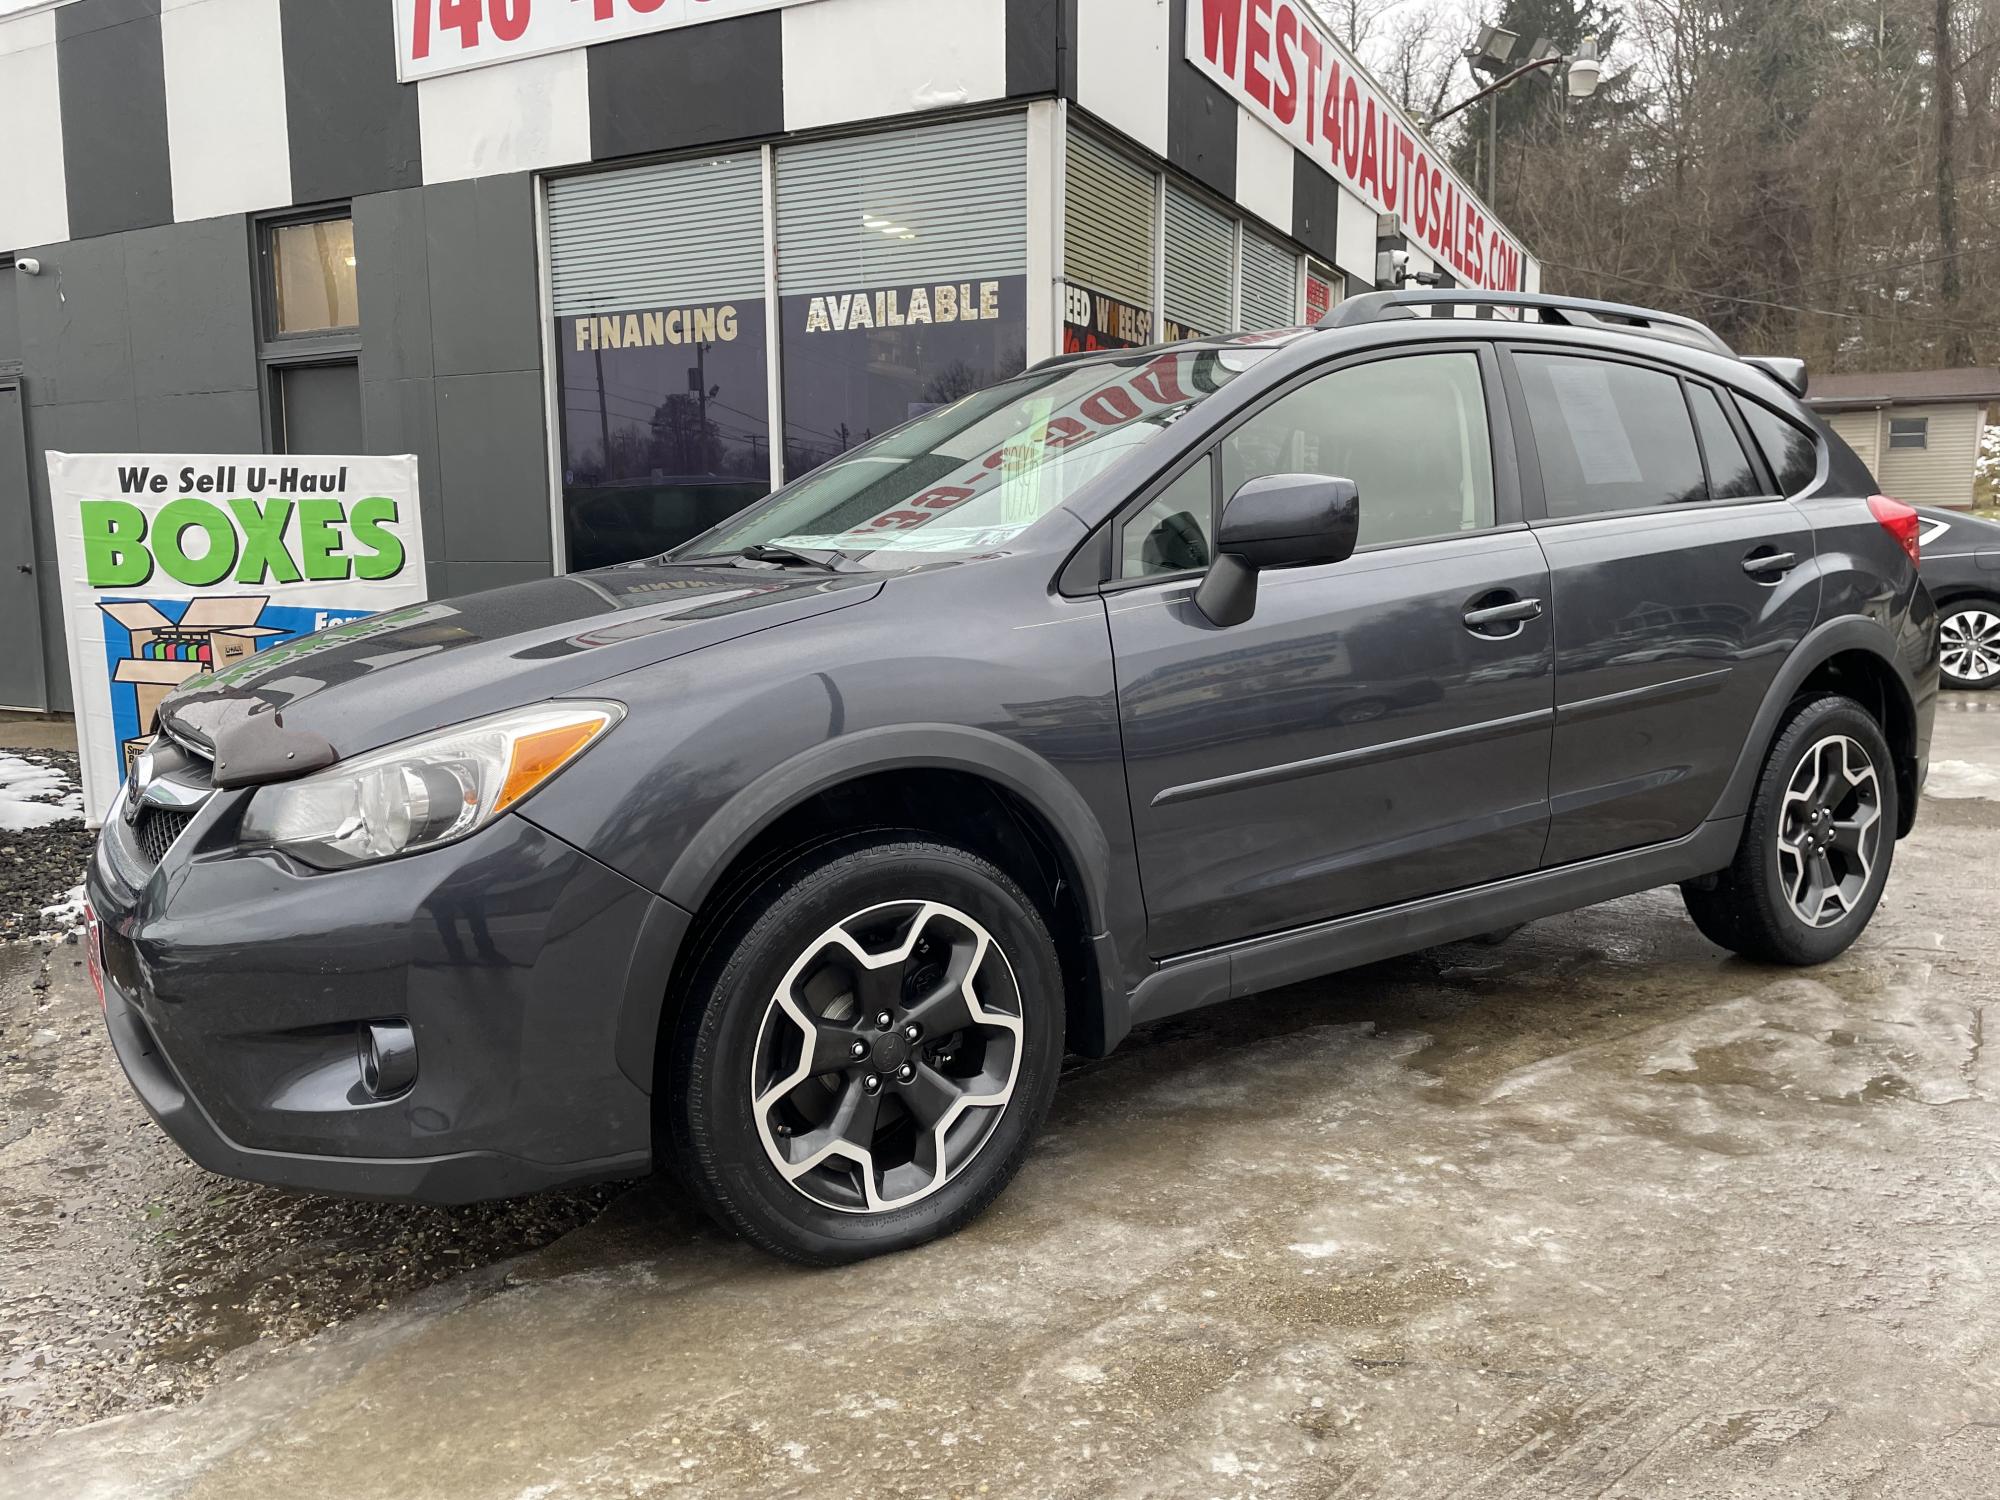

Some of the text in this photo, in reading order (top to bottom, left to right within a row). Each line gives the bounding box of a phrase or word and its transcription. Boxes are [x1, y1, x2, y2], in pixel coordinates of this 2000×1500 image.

[575, 280, 1000, 352] FINANCING AVAILABLE
[1064, 284, 1091, 328] EED
[118, 465, 347, 493] We Sell U-Haul
[80, 497, 406, 588] BOXES
[127, 745, 145, 756] Sma
